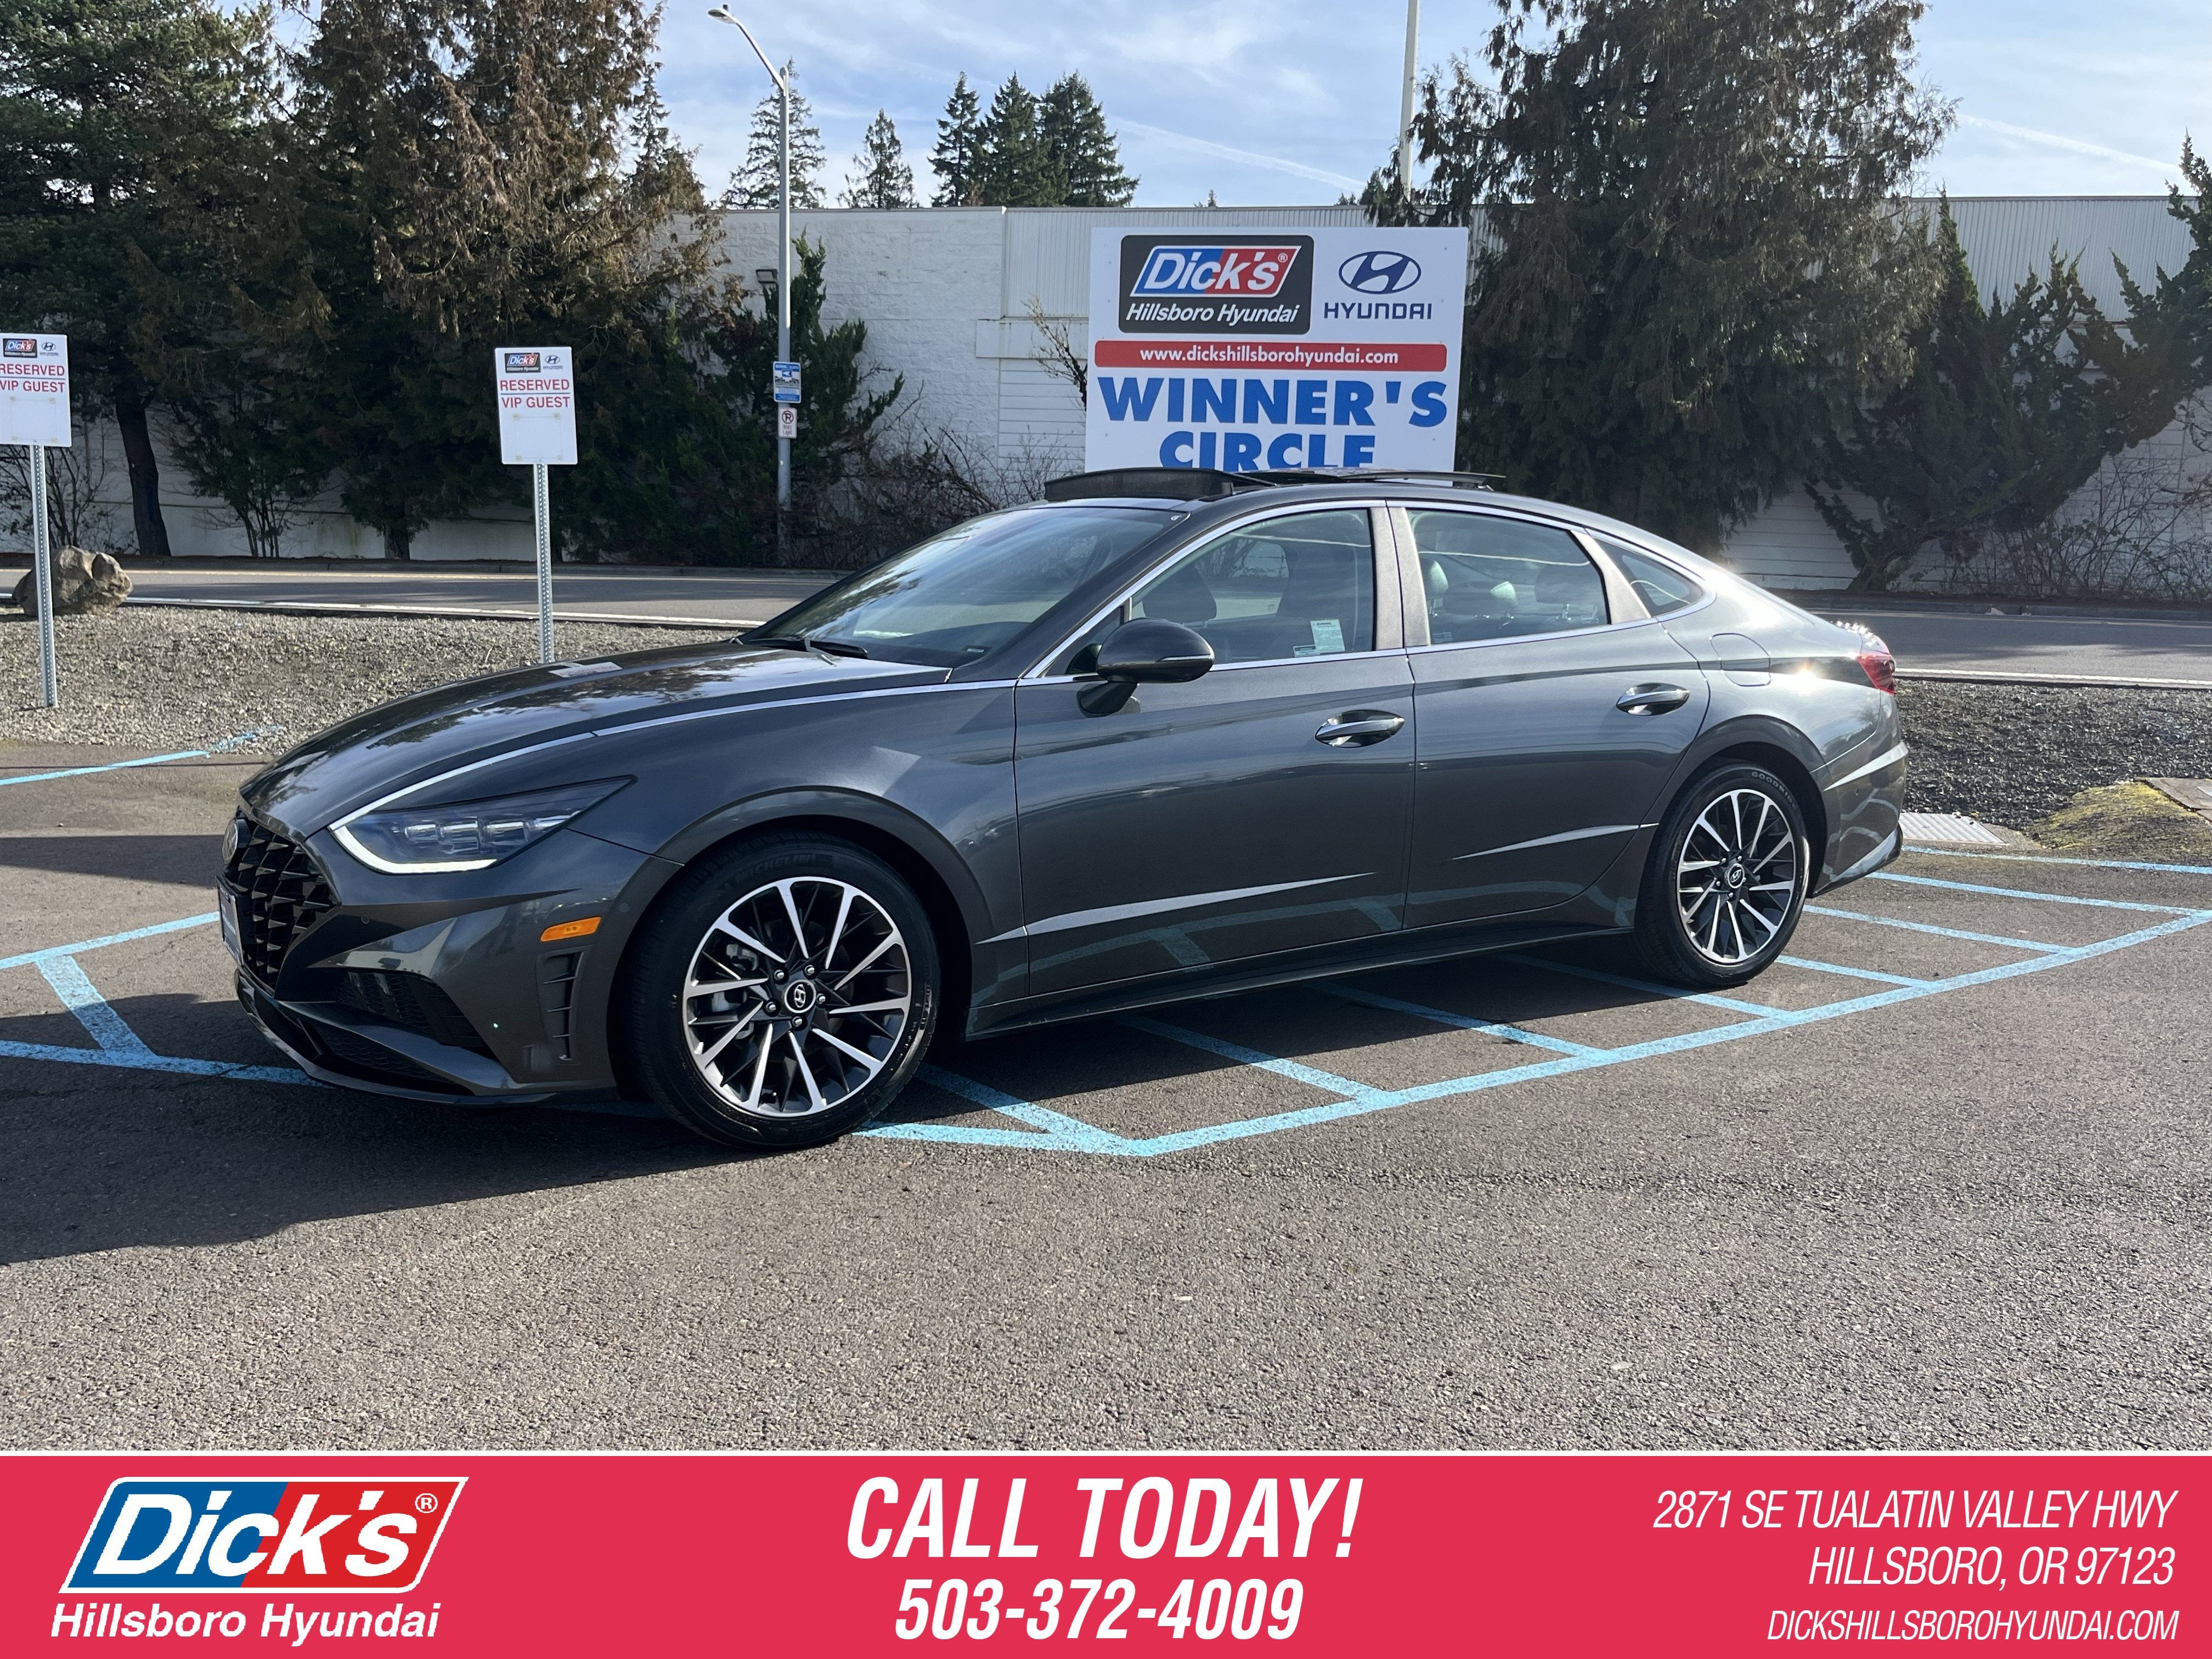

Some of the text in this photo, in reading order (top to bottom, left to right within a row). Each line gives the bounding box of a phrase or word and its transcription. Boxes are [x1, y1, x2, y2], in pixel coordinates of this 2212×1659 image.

[1144, 252, 1279, 290] Dick's
[1126, 303, 1300, 326] Hillsboro Hyundai
[1324, 302, 1432, 319] HYUNDAI
[7, 341, 32, 350] Dick's
[509, 356, 535, 365] Dick's
[1140, 346, 1398, 365] www.dickshillsborohyundai.com
[0, 364, 65, 376] RESERVED
[0, 380, 65, 392] VIP GUEST
[500, 379, 569, 391] RESERVED
[501, 396, 570, 408] VIP GUEST
[1097, 377, 1447, 427] WINNER'S
[1159, 431, 1376, 471] CIRCLE
